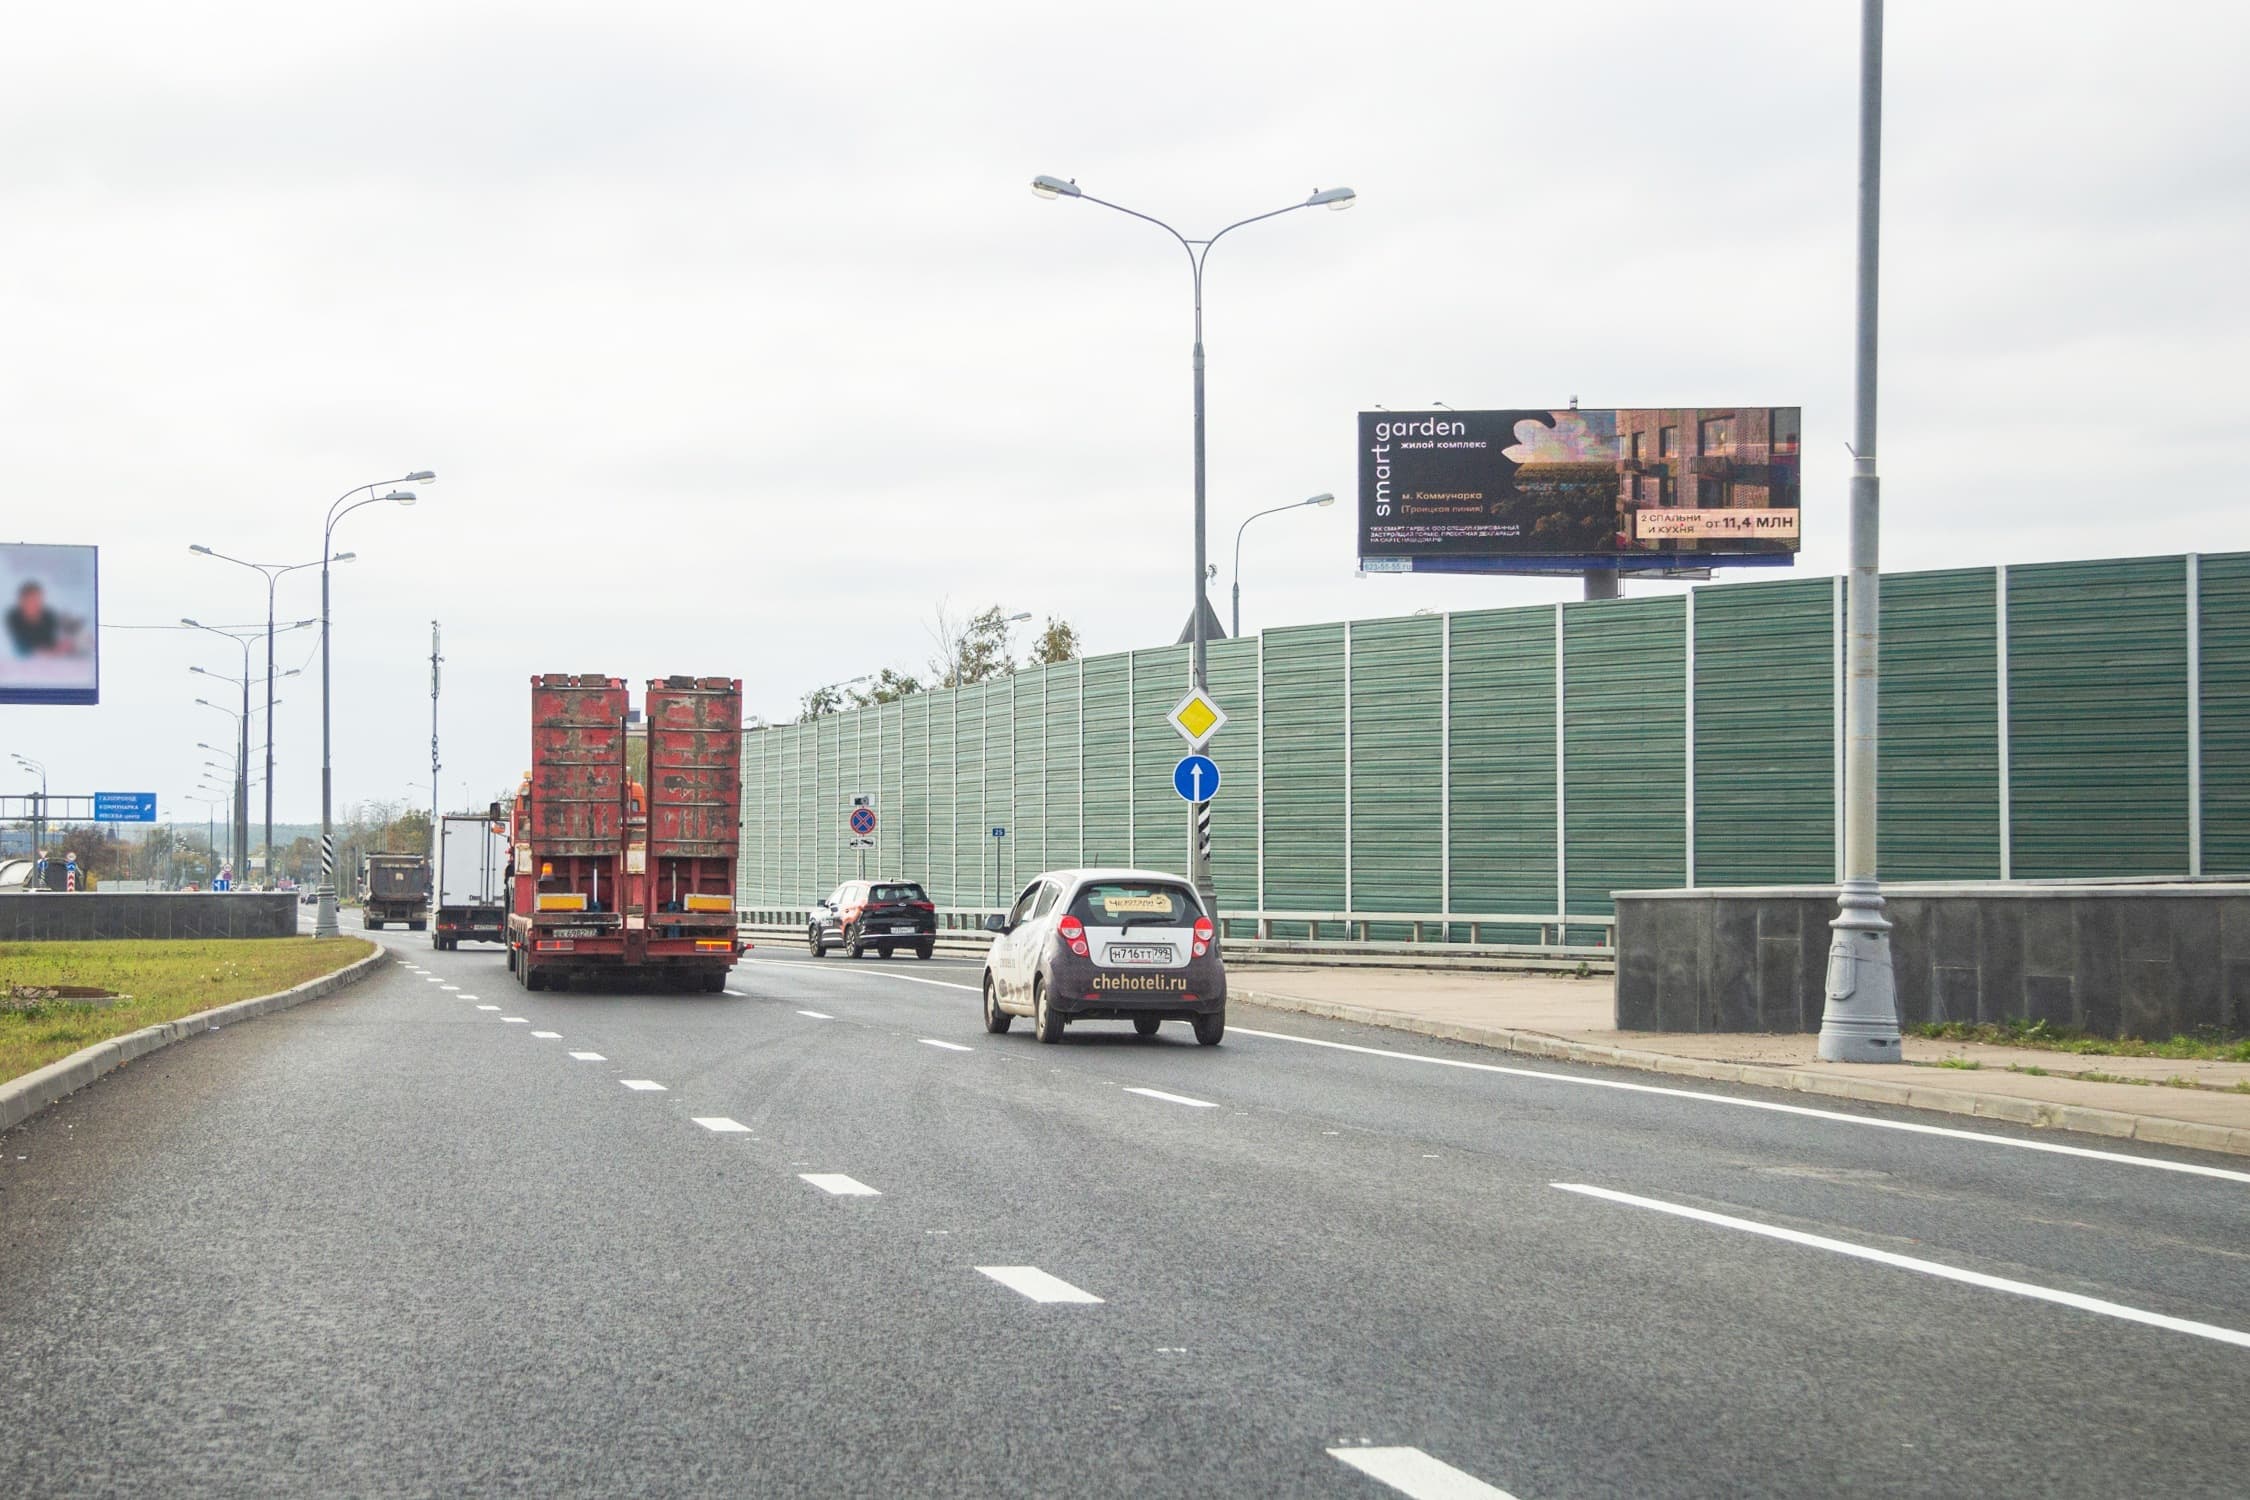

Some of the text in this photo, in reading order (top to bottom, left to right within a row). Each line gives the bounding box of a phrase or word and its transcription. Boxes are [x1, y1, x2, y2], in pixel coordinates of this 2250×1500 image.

[1376, 417, 1465, 441] garden
[1400, 441, 1487, 449] жилой комплекс
[1371, 444, 1391, 517] smart
[1416, 491, 1482, 501] Коммунарка
[1650, 514, 1701, 522] СПАЛЬНИ
[1705, 517, 1793, 531] от 11,4 МЛН
[1658, 526, 1695, 534] КУХНЯ
[1114, 948, 1152, 959] Н716ТТ
[1092, 973, 1188, 991] chehoteli.ru
